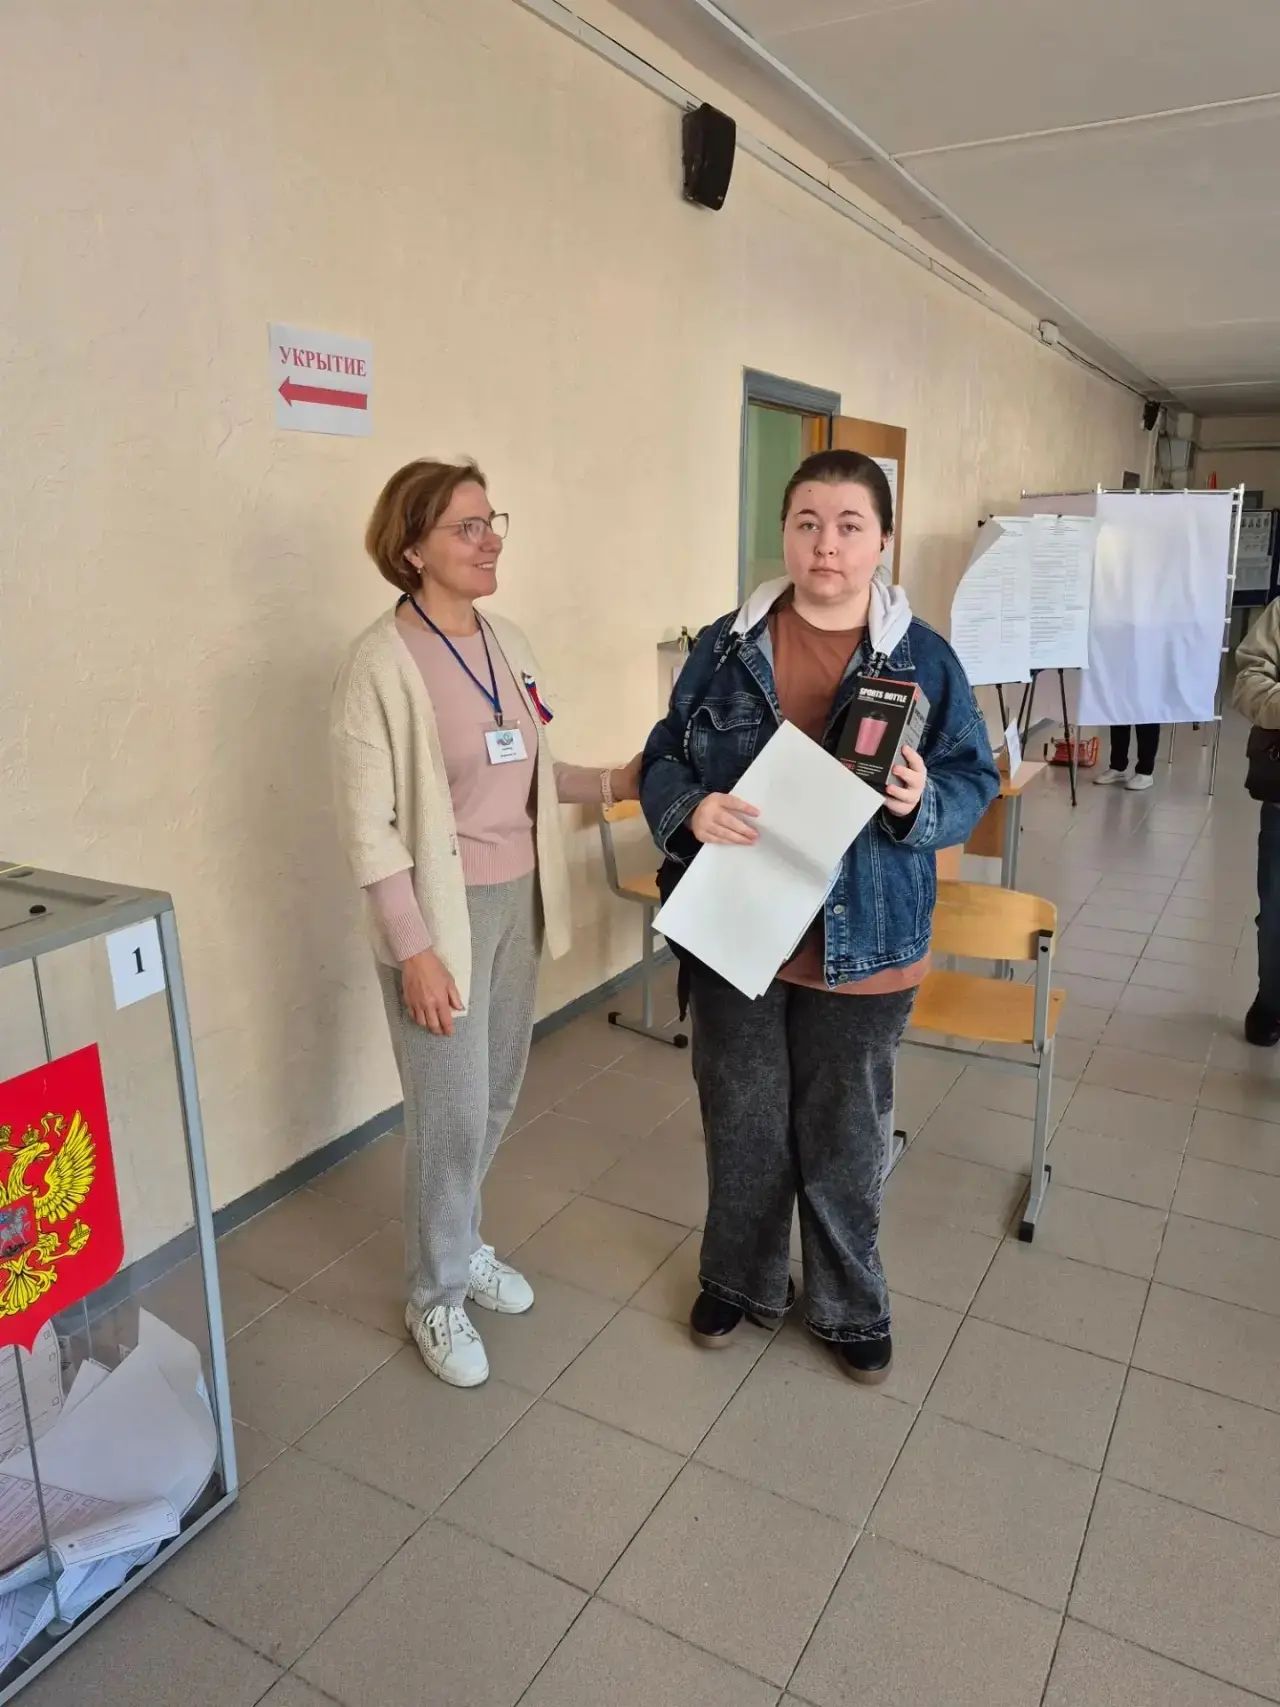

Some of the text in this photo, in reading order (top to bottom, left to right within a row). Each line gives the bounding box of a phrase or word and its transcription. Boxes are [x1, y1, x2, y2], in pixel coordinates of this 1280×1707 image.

[279, 346, 366, 377] УКРЫТИЕ
[859, 687, 884, 699] SPORTS
[884, 691, 908, 703] BOTTLE
[132, 946, 146, 975] 1
